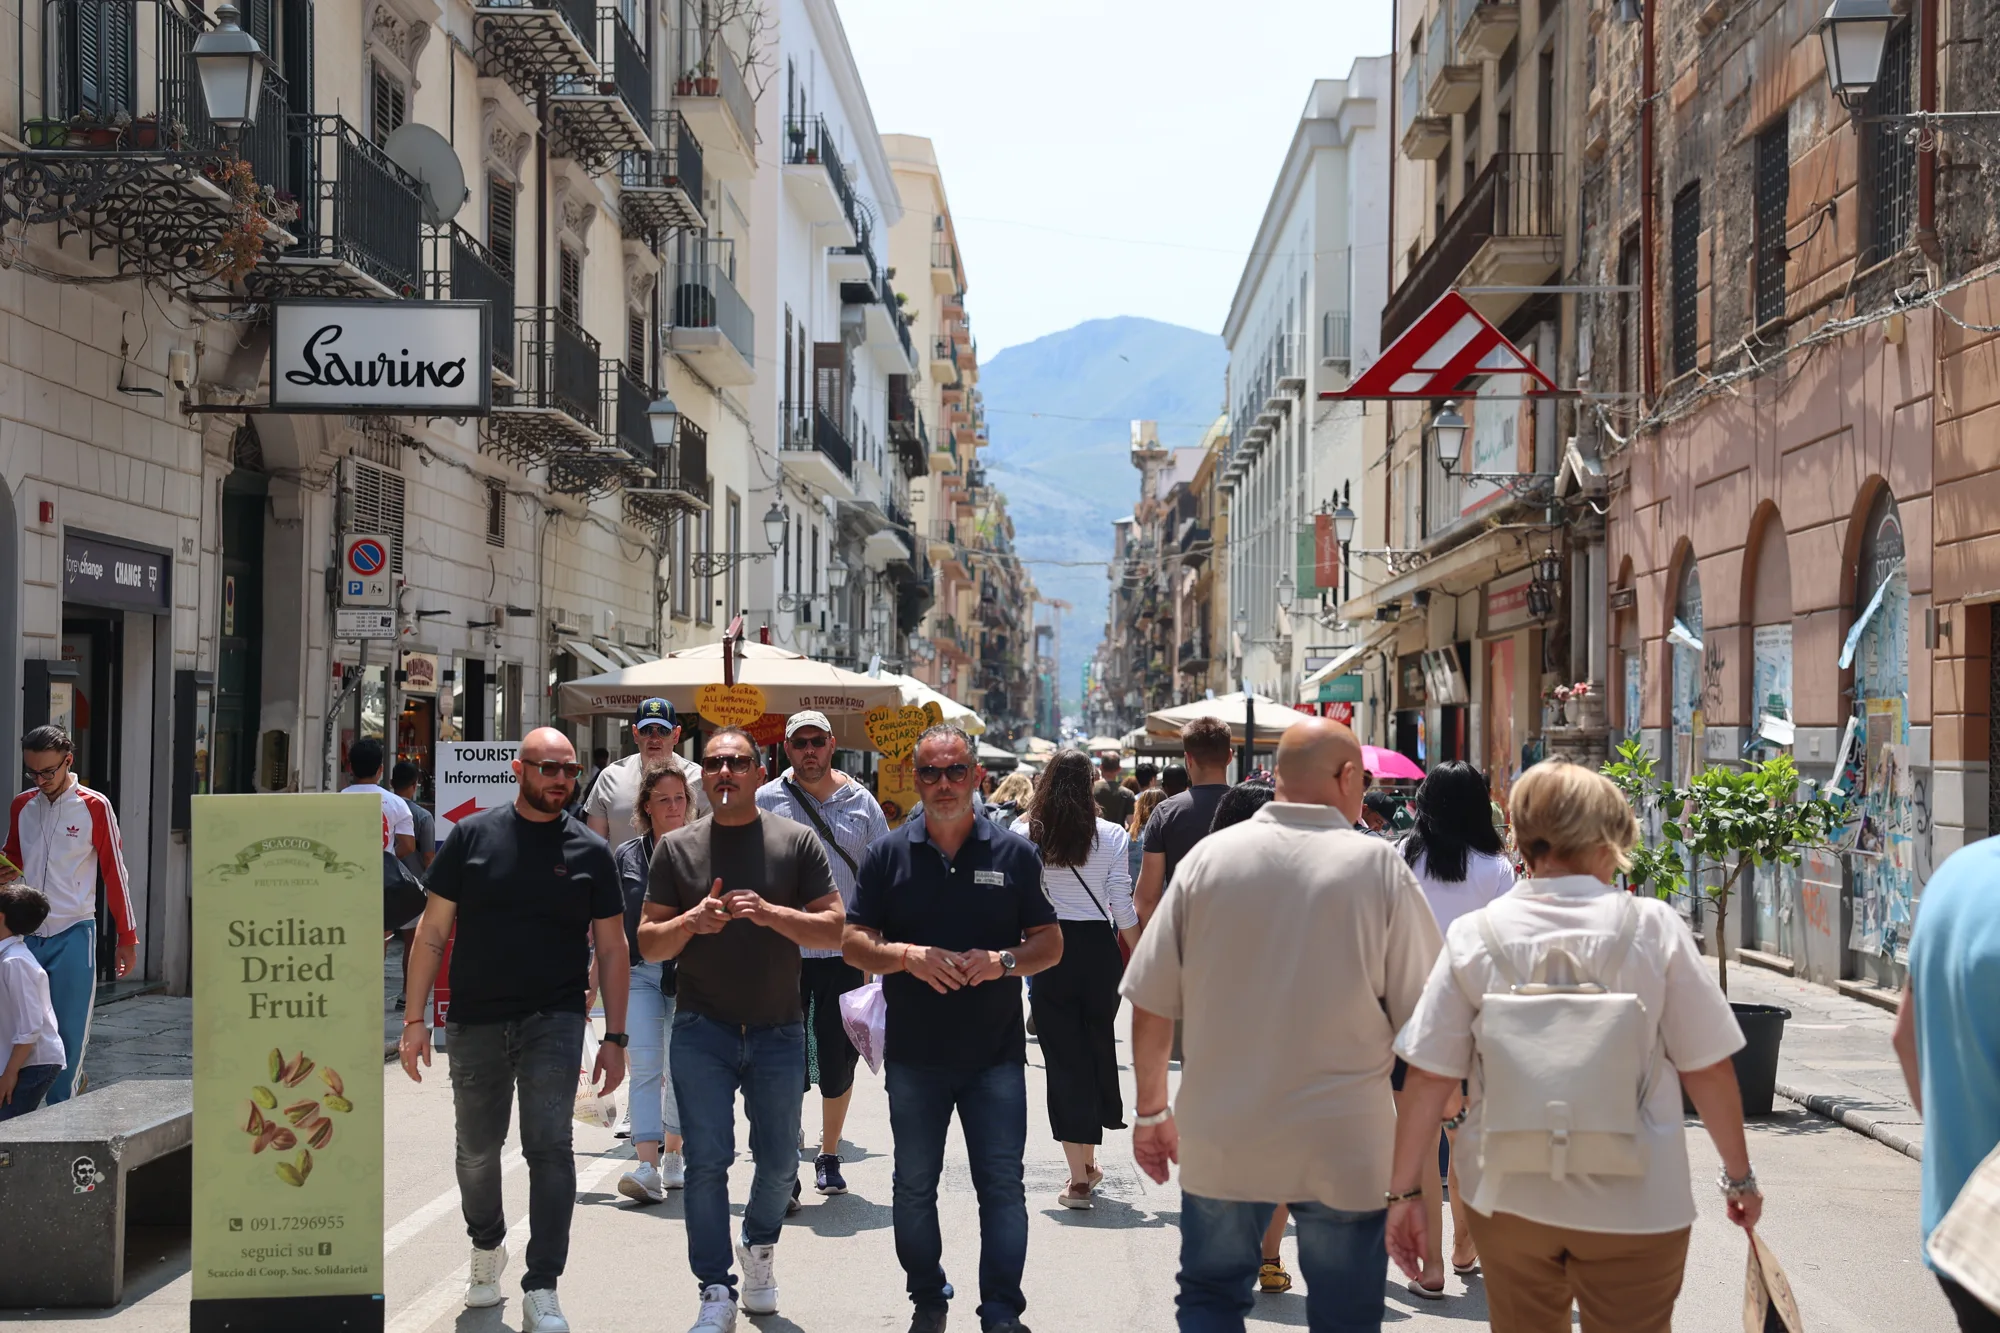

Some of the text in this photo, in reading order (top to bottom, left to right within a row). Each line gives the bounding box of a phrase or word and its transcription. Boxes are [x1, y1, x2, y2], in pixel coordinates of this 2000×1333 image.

[285, 324, 466, 388] Laurino
[114, 562, 142, 587] CHANGE
[591, 697, 602, 705] LA
[800, 696, 864, 708] LA TAVERNERIA
[899, 709, 923, 720] SOTTO
[1326, 702, 1350, 722] illy
[454, 748, 517, 761] TOURIST
[445, 771, 517, 784] Informatio
[262, 838, 310, 850] SCACCIO
[254, 879, 289, 887] FRUTTA
[228, 918, 346, 947] Sicilian
[241, 953, 334, 983] Dried
[248, 992, 328, 1019] Fruit
[250, 1216, 345, 1231] 091.7296955
[241, 1244, 292, 1262] seguici
[297, 1246, 314, 1257] su
[207, 1265, 368, 1279] Scaccio di Coop. Soc. Solidarietà
